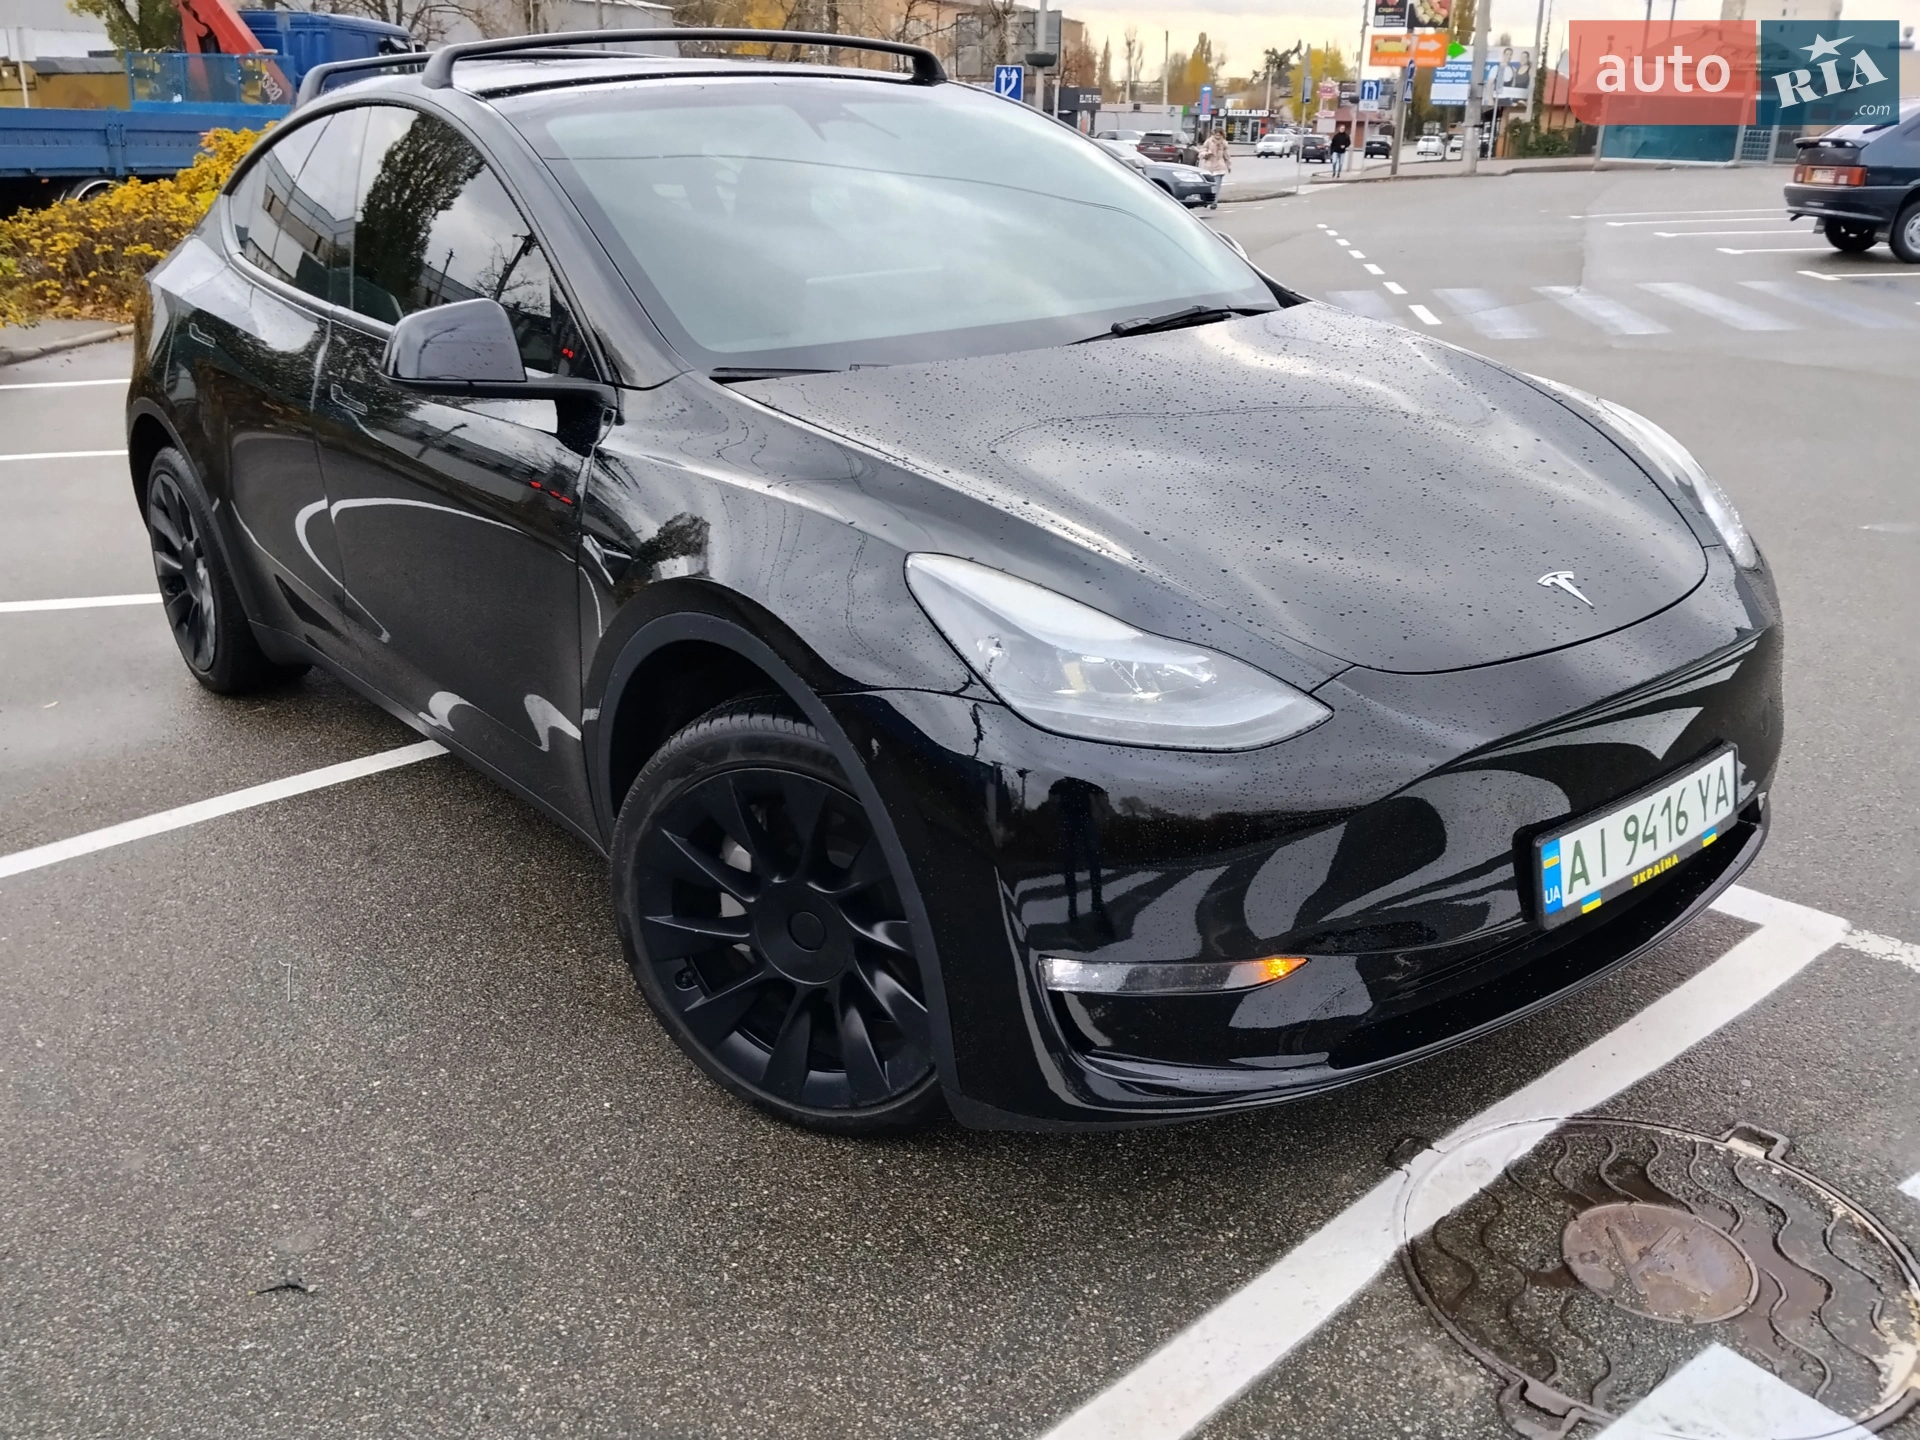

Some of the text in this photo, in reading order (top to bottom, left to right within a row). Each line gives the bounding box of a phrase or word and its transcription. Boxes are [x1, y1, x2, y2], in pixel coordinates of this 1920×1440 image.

[1227, 109, 1270, 117] BEERLAND
[1568, 766, 1729, 894] AI 9416 YA
[1632, 854, 1679, 887] УКРАЇНА
[1545, 885, 1561, 904] UA
